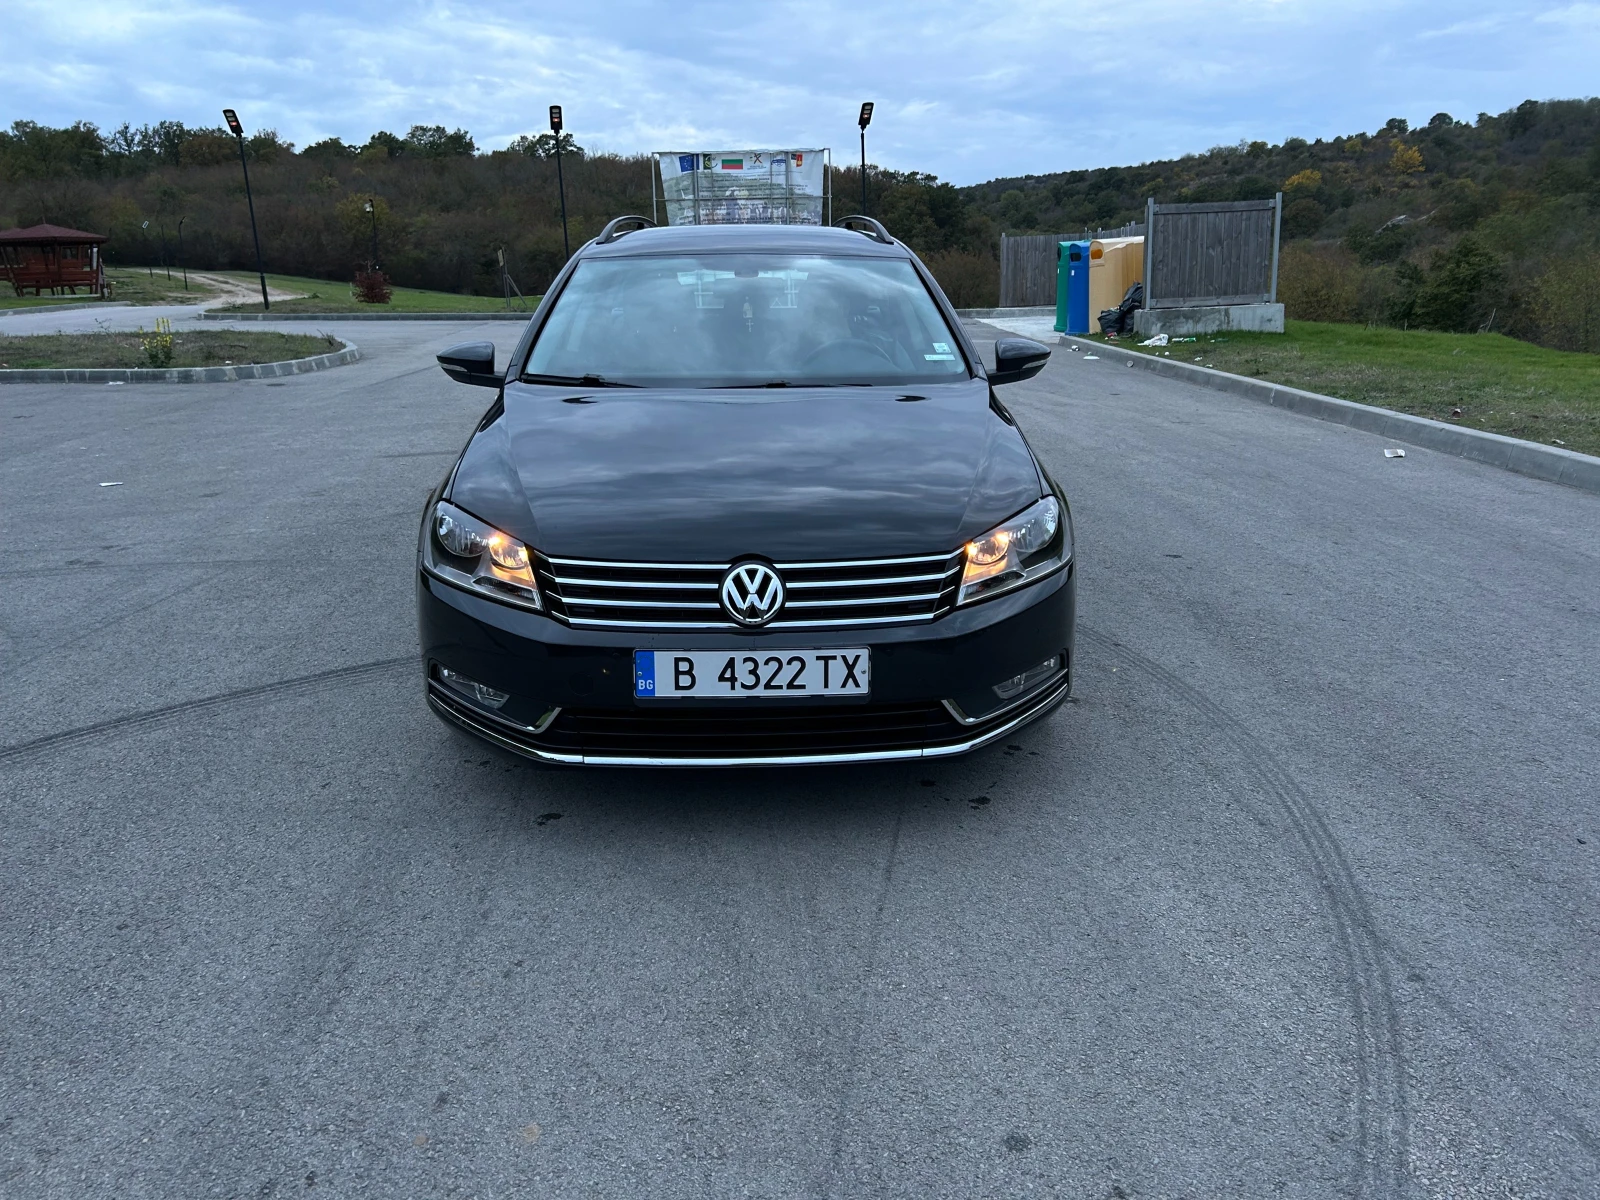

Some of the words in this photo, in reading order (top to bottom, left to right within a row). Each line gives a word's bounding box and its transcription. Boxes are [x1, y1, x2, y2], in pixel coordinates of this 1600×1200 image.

[723, 565, 783, 621] VW
[638, 679, 654, 690] BG
[673, 656, 697, 691] B
[717, 655, 807, 691] 4322
[815, 654, 862, 689] TX
